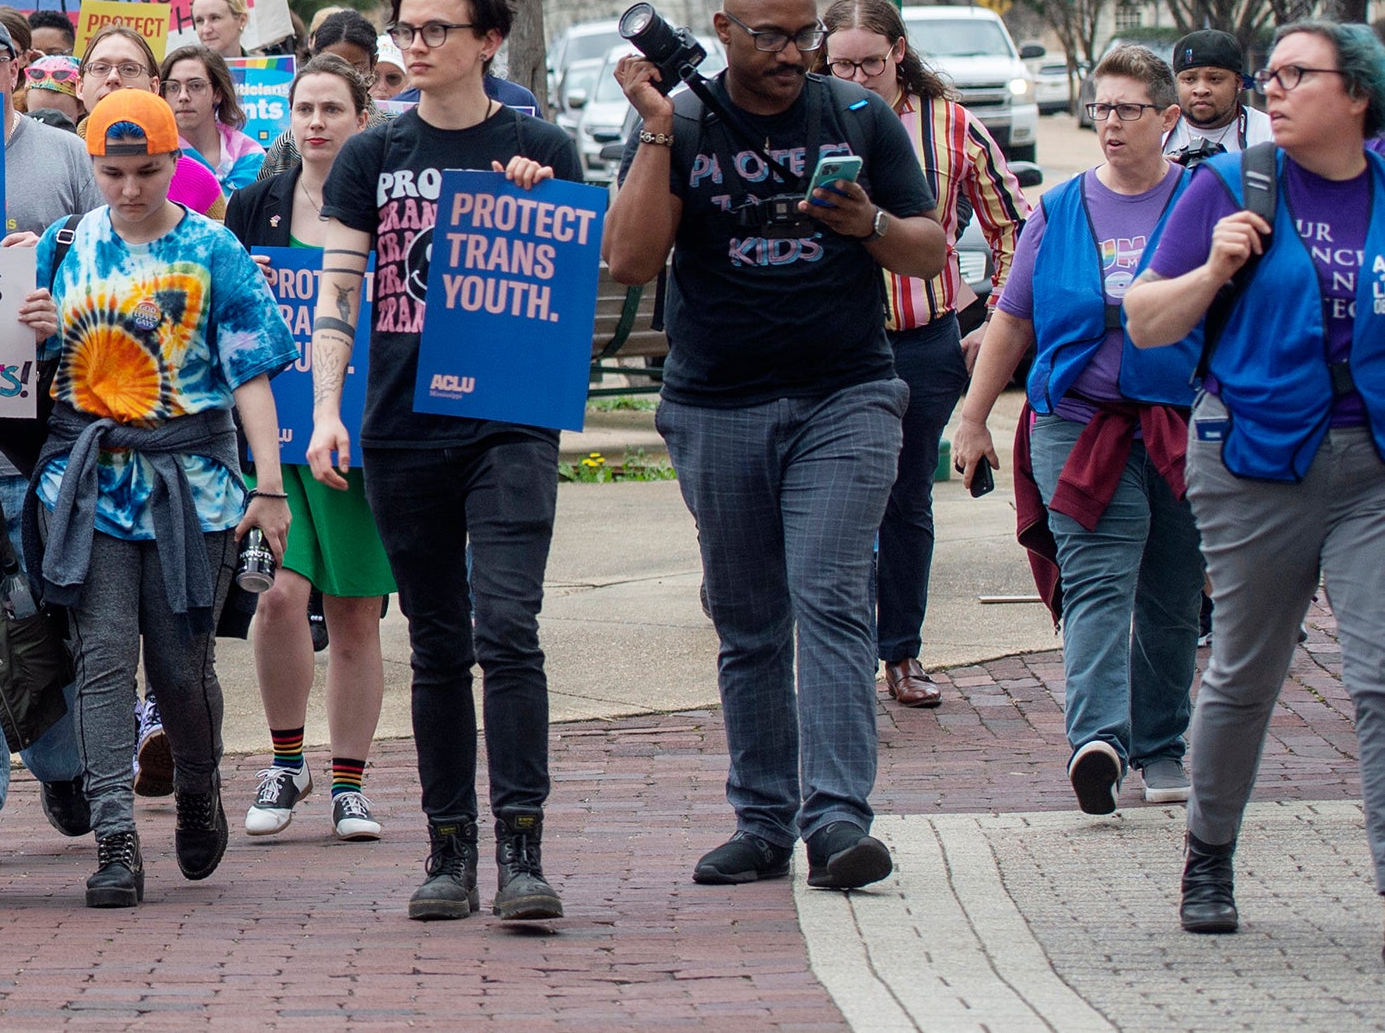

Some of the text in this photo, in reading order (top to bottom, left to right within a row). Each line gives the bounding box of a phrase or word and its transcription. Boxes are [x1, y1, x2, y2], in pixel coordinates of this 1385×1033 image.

[377, 198, 438, 235] TRAN
[450, 193, 596, 246] PROTECT
[447, 232, 556, 280] TRANS
[728, 233, 824, 266] KIDS
[376, 295, 426, 333] TRAN
[442, 273, 559, 323] YOUTH.
[430, 374, 475, 393] ACLU
